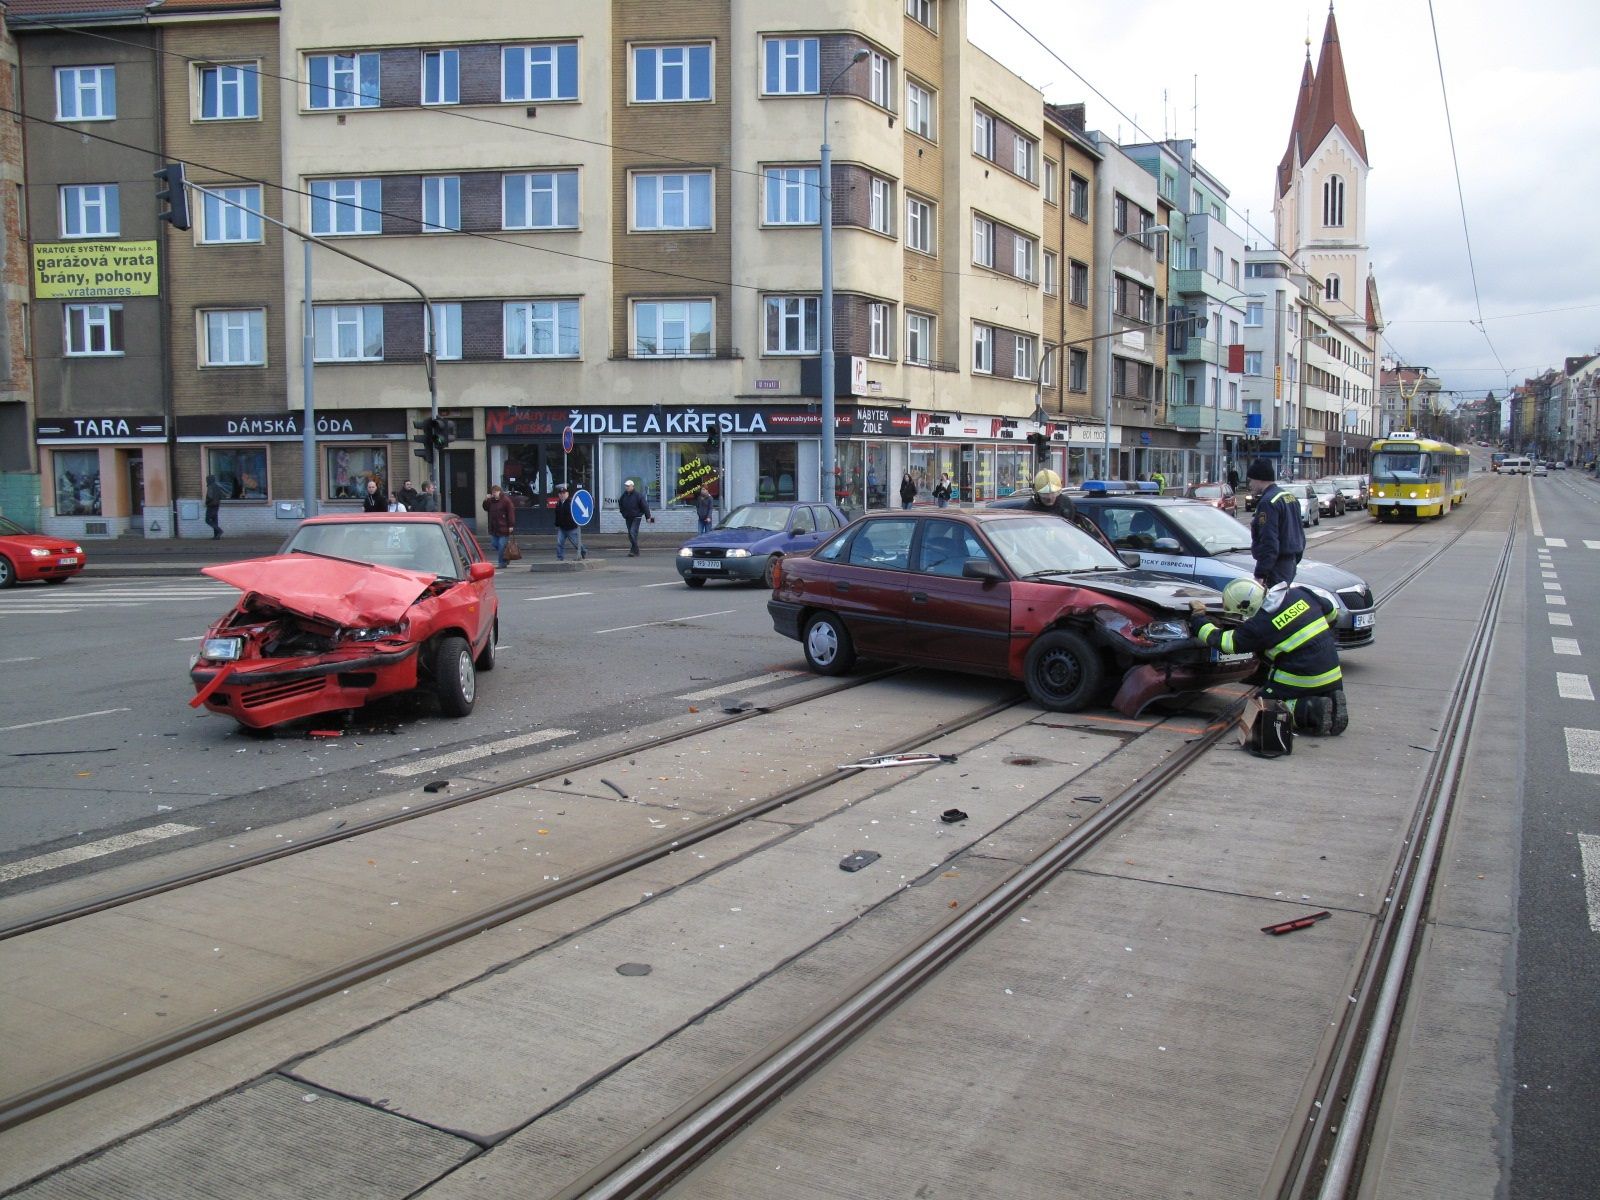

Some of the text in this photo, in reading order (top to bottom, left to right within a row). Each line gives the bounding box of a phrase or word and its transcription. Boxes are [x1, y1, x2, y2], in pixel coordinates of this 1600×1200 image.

[78, 244, 116, 253] SYSTÉMY
[36, 254, 155, 271] garážová vrata
[40, 270, 152, 286] brány, pohony
[568, 409, 767, 433] ŽIDLE A KŘESLA
[857, 407, 889, 421] NÁBYTEK
[74, 419, 130, 436] TARA
[227, 416, 353, 433] DÁMSKÁ ÓDA
[863, 420, 883, 434] ŽIDLE
[679, 464, 712, 486] e-shop
